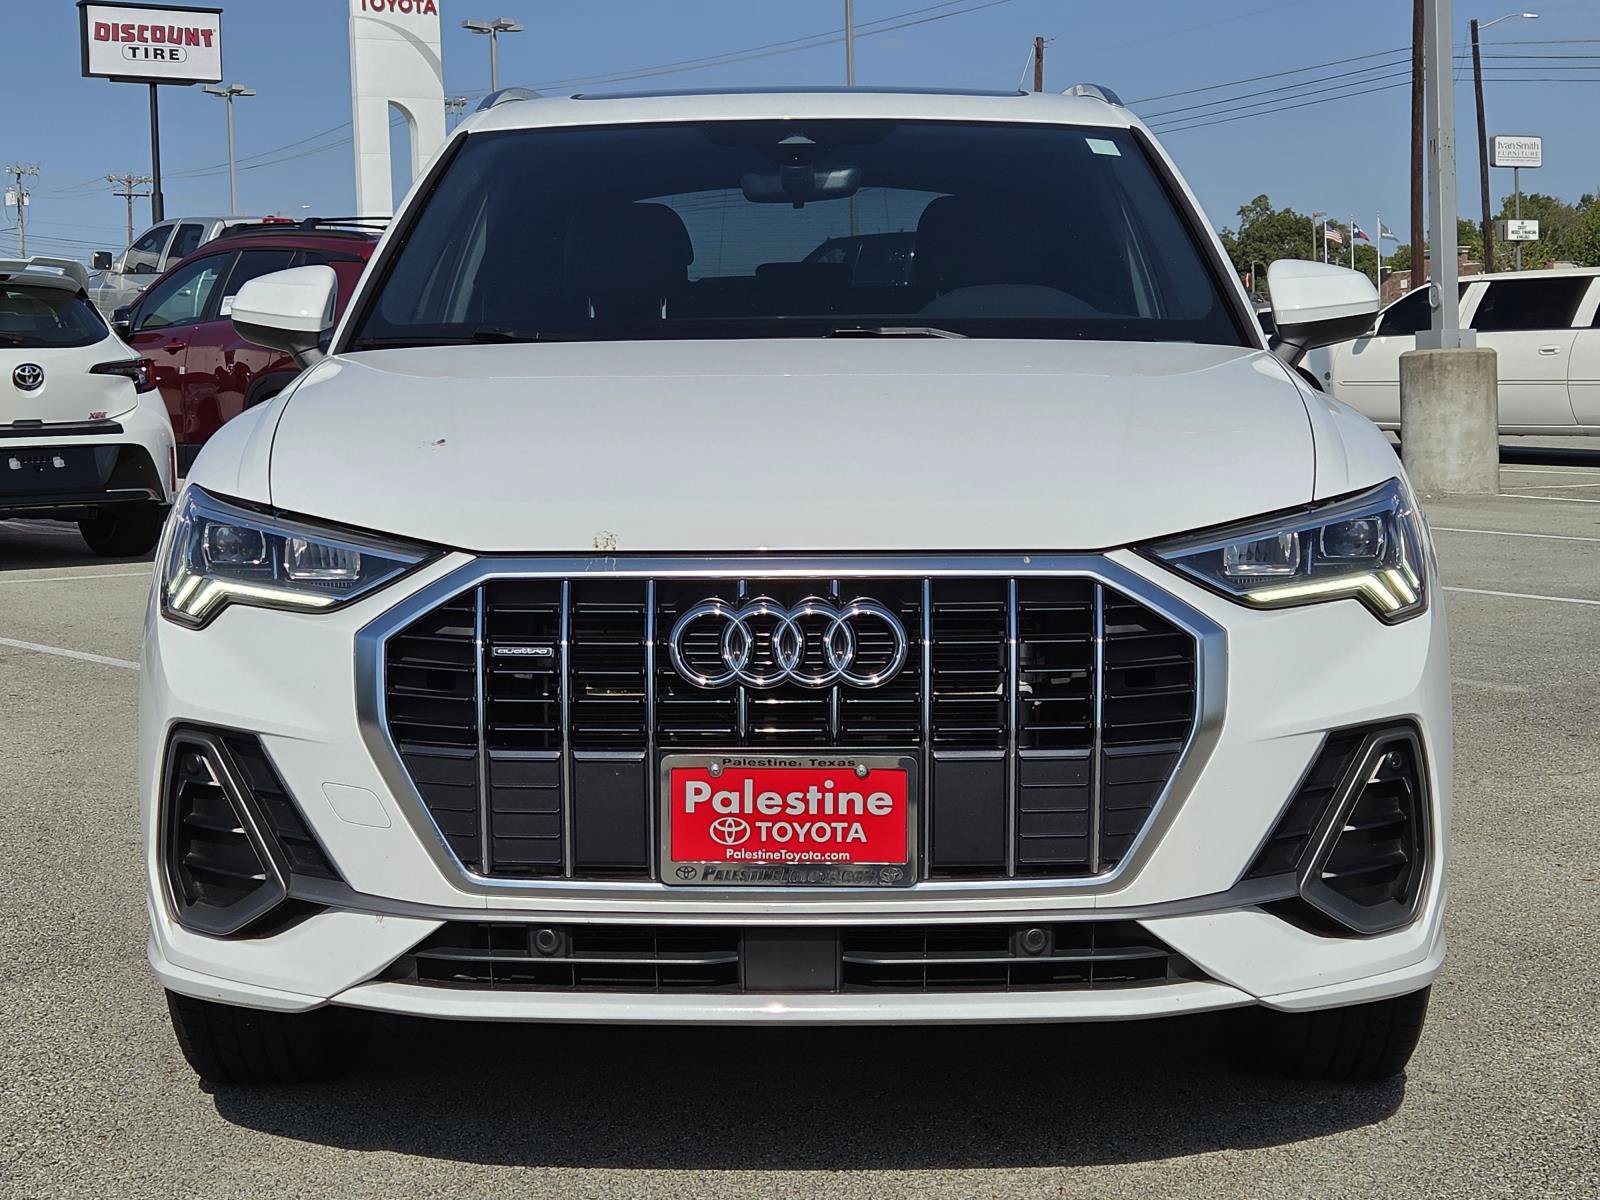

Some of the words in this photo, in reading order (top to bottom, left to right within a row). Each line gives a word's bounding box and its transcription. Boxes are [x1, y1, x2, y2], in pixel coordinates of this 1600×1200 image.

[361, 0, 437, 16] TOYOTA
[94, 22, 213, 47] DISCOUNT
[128, 46, 180, 61] TIRE
[722, 758, 802, 767] Palestine,
[809, 759, 856, 767] Texas
[685, 779, 893, 815] Palestine
[755, 822, 867, 843] TOYOTA
[726, 848, 850, 861] PalestineToyota.com
